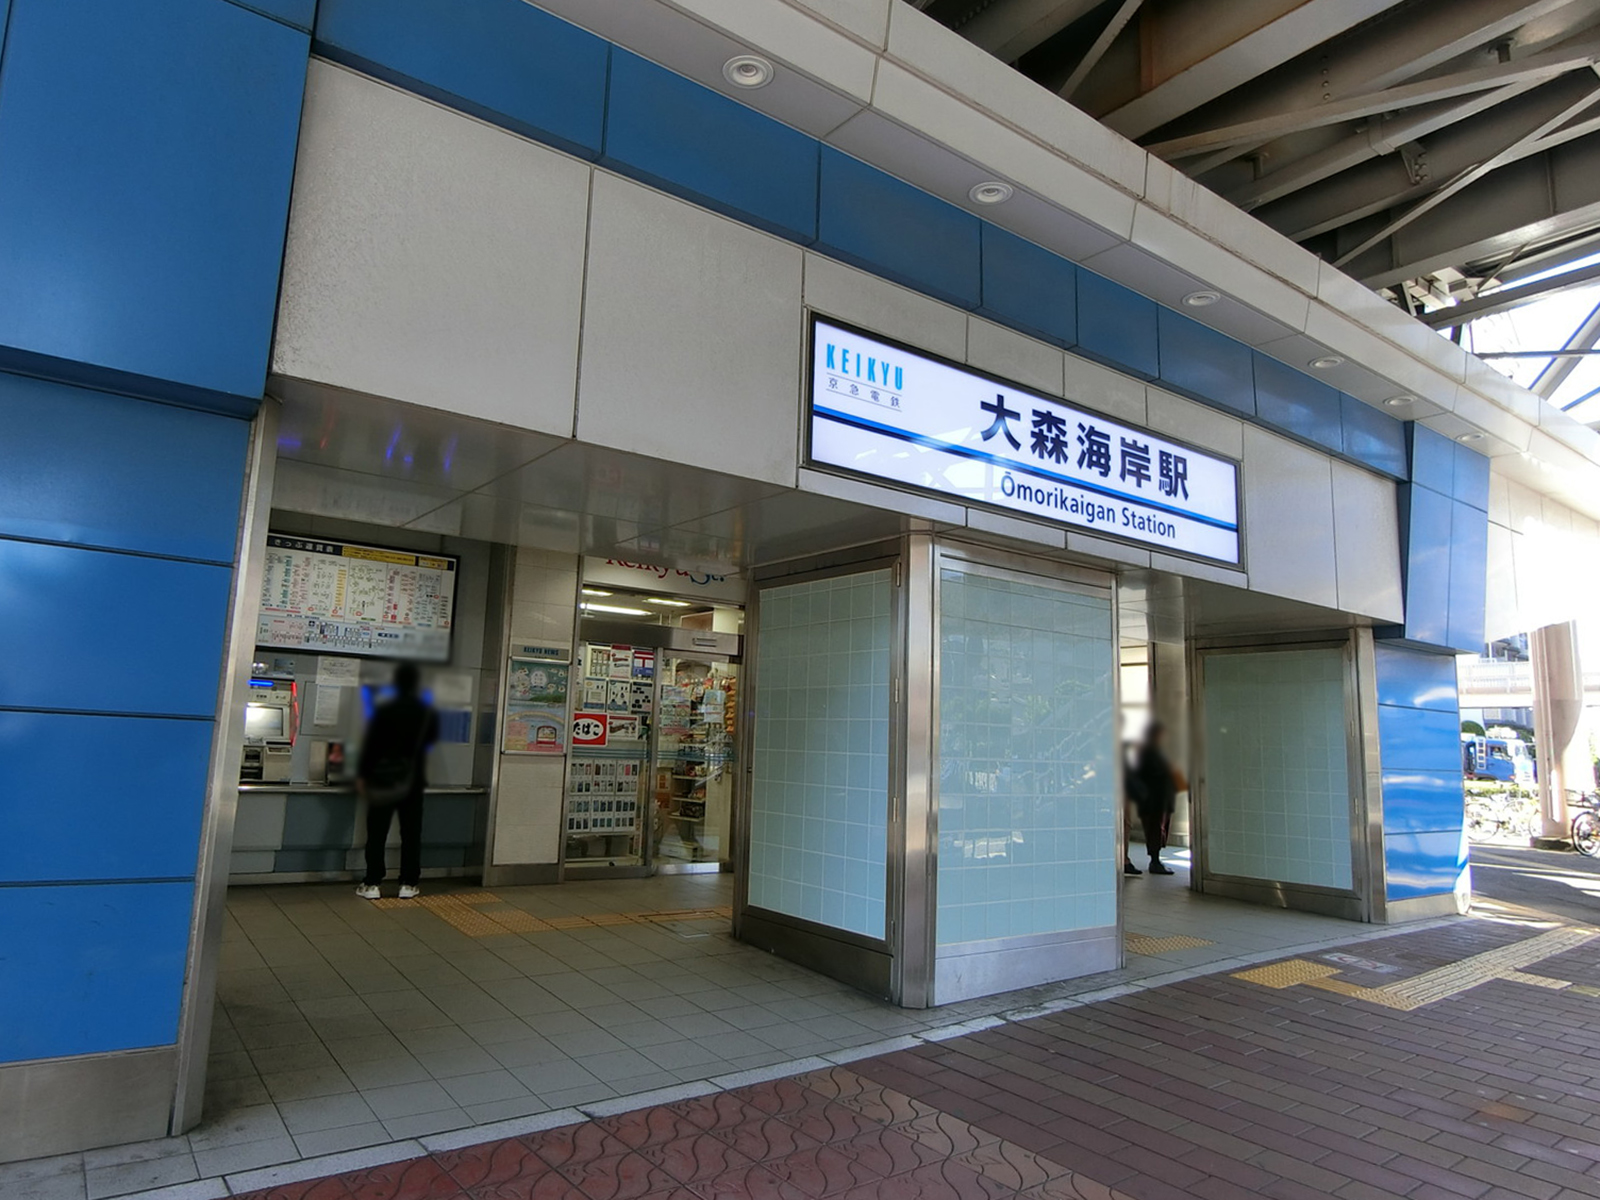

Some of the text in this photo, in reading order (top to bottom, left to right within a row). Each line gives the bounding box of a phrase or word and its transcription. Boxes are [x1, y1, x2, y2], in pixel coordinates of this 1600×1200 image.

[826, 343, 903, 391] KEIKYU
[828, 377, 901, 408] 京急電鉄
[980, 394, 1189, 501] 大森海岸駅
[1001, 471, 1176, 539] Ōmorikaigan Station
[573, 721, 600, 736] たばこ
